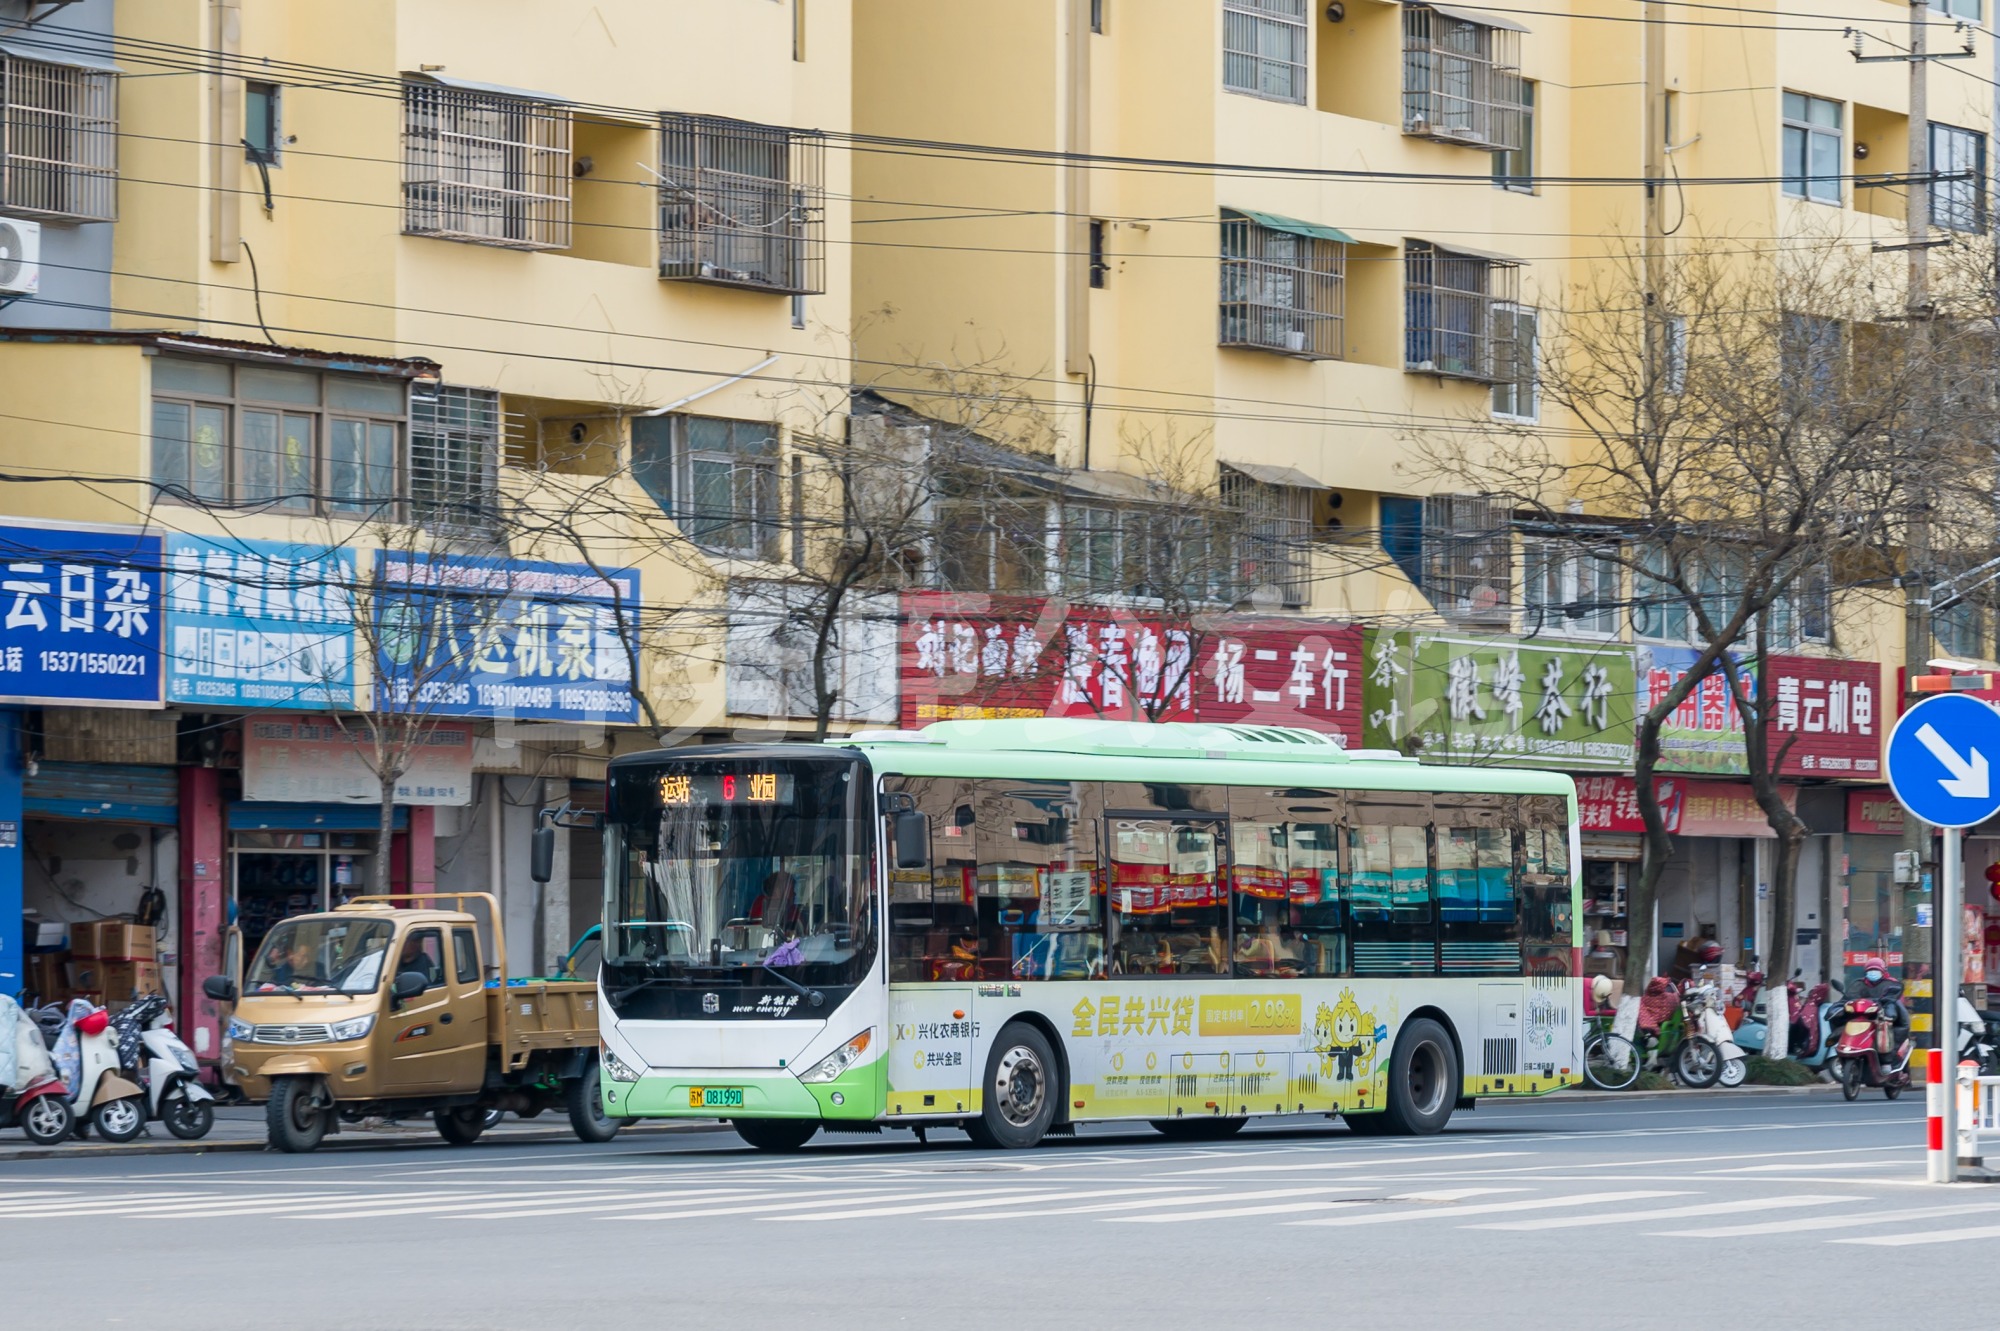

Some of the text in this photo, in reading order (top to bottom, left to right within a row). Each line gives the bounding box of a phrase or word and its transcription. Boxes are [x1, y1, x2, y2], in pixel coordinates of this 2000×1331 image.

[2, 560, 151, 639] 云日杂
[426, 598, 597, 682] 八达机泵
[40, 650, 146, 676] 15371550221
[1213, 638, 1350, 712] 杨二车行
[475, 684, 553, 709] 18961082458
[1367, 637, 1409, 743] 茶叶
[1776, 675, 1873, 737] 青云机电
[723, 775, 736, 801] 6
[732, 1003, 793, 1018] new energy
[757, 994, 800, 1007] 新能源
[1071, 994, 1196, 1037] 全民共兴贷
[1249, 999, 1297, 1029] 2.98%
[918, 1021, 981, 1040] 兴化农商银行
[926, 1052, 963, 1067] 共兴金融
[706, 1089, 743, 1106] 08199D
